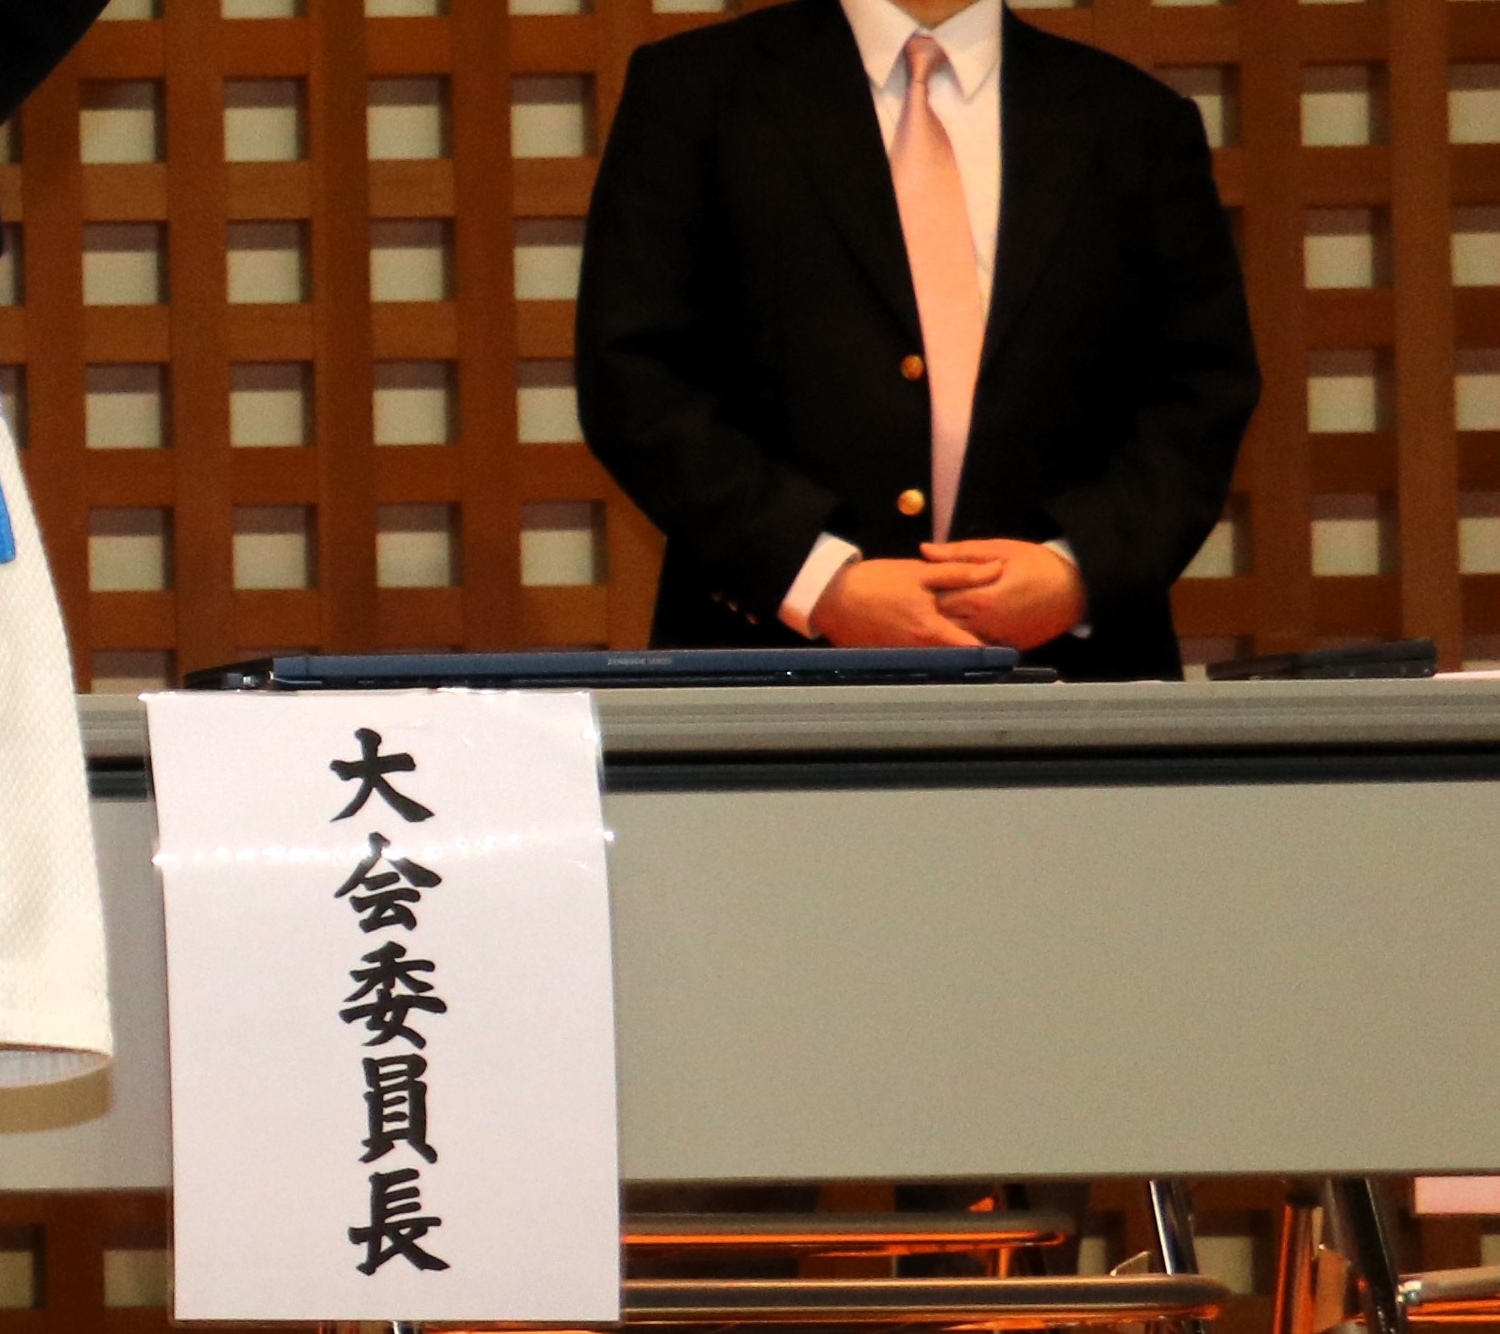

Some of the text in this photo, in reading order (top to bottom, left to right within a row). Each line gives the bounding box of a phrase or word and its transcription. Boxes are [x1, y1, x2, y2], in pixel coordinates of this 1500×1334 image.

[328, 727, 451, 1277] 大会委員長
